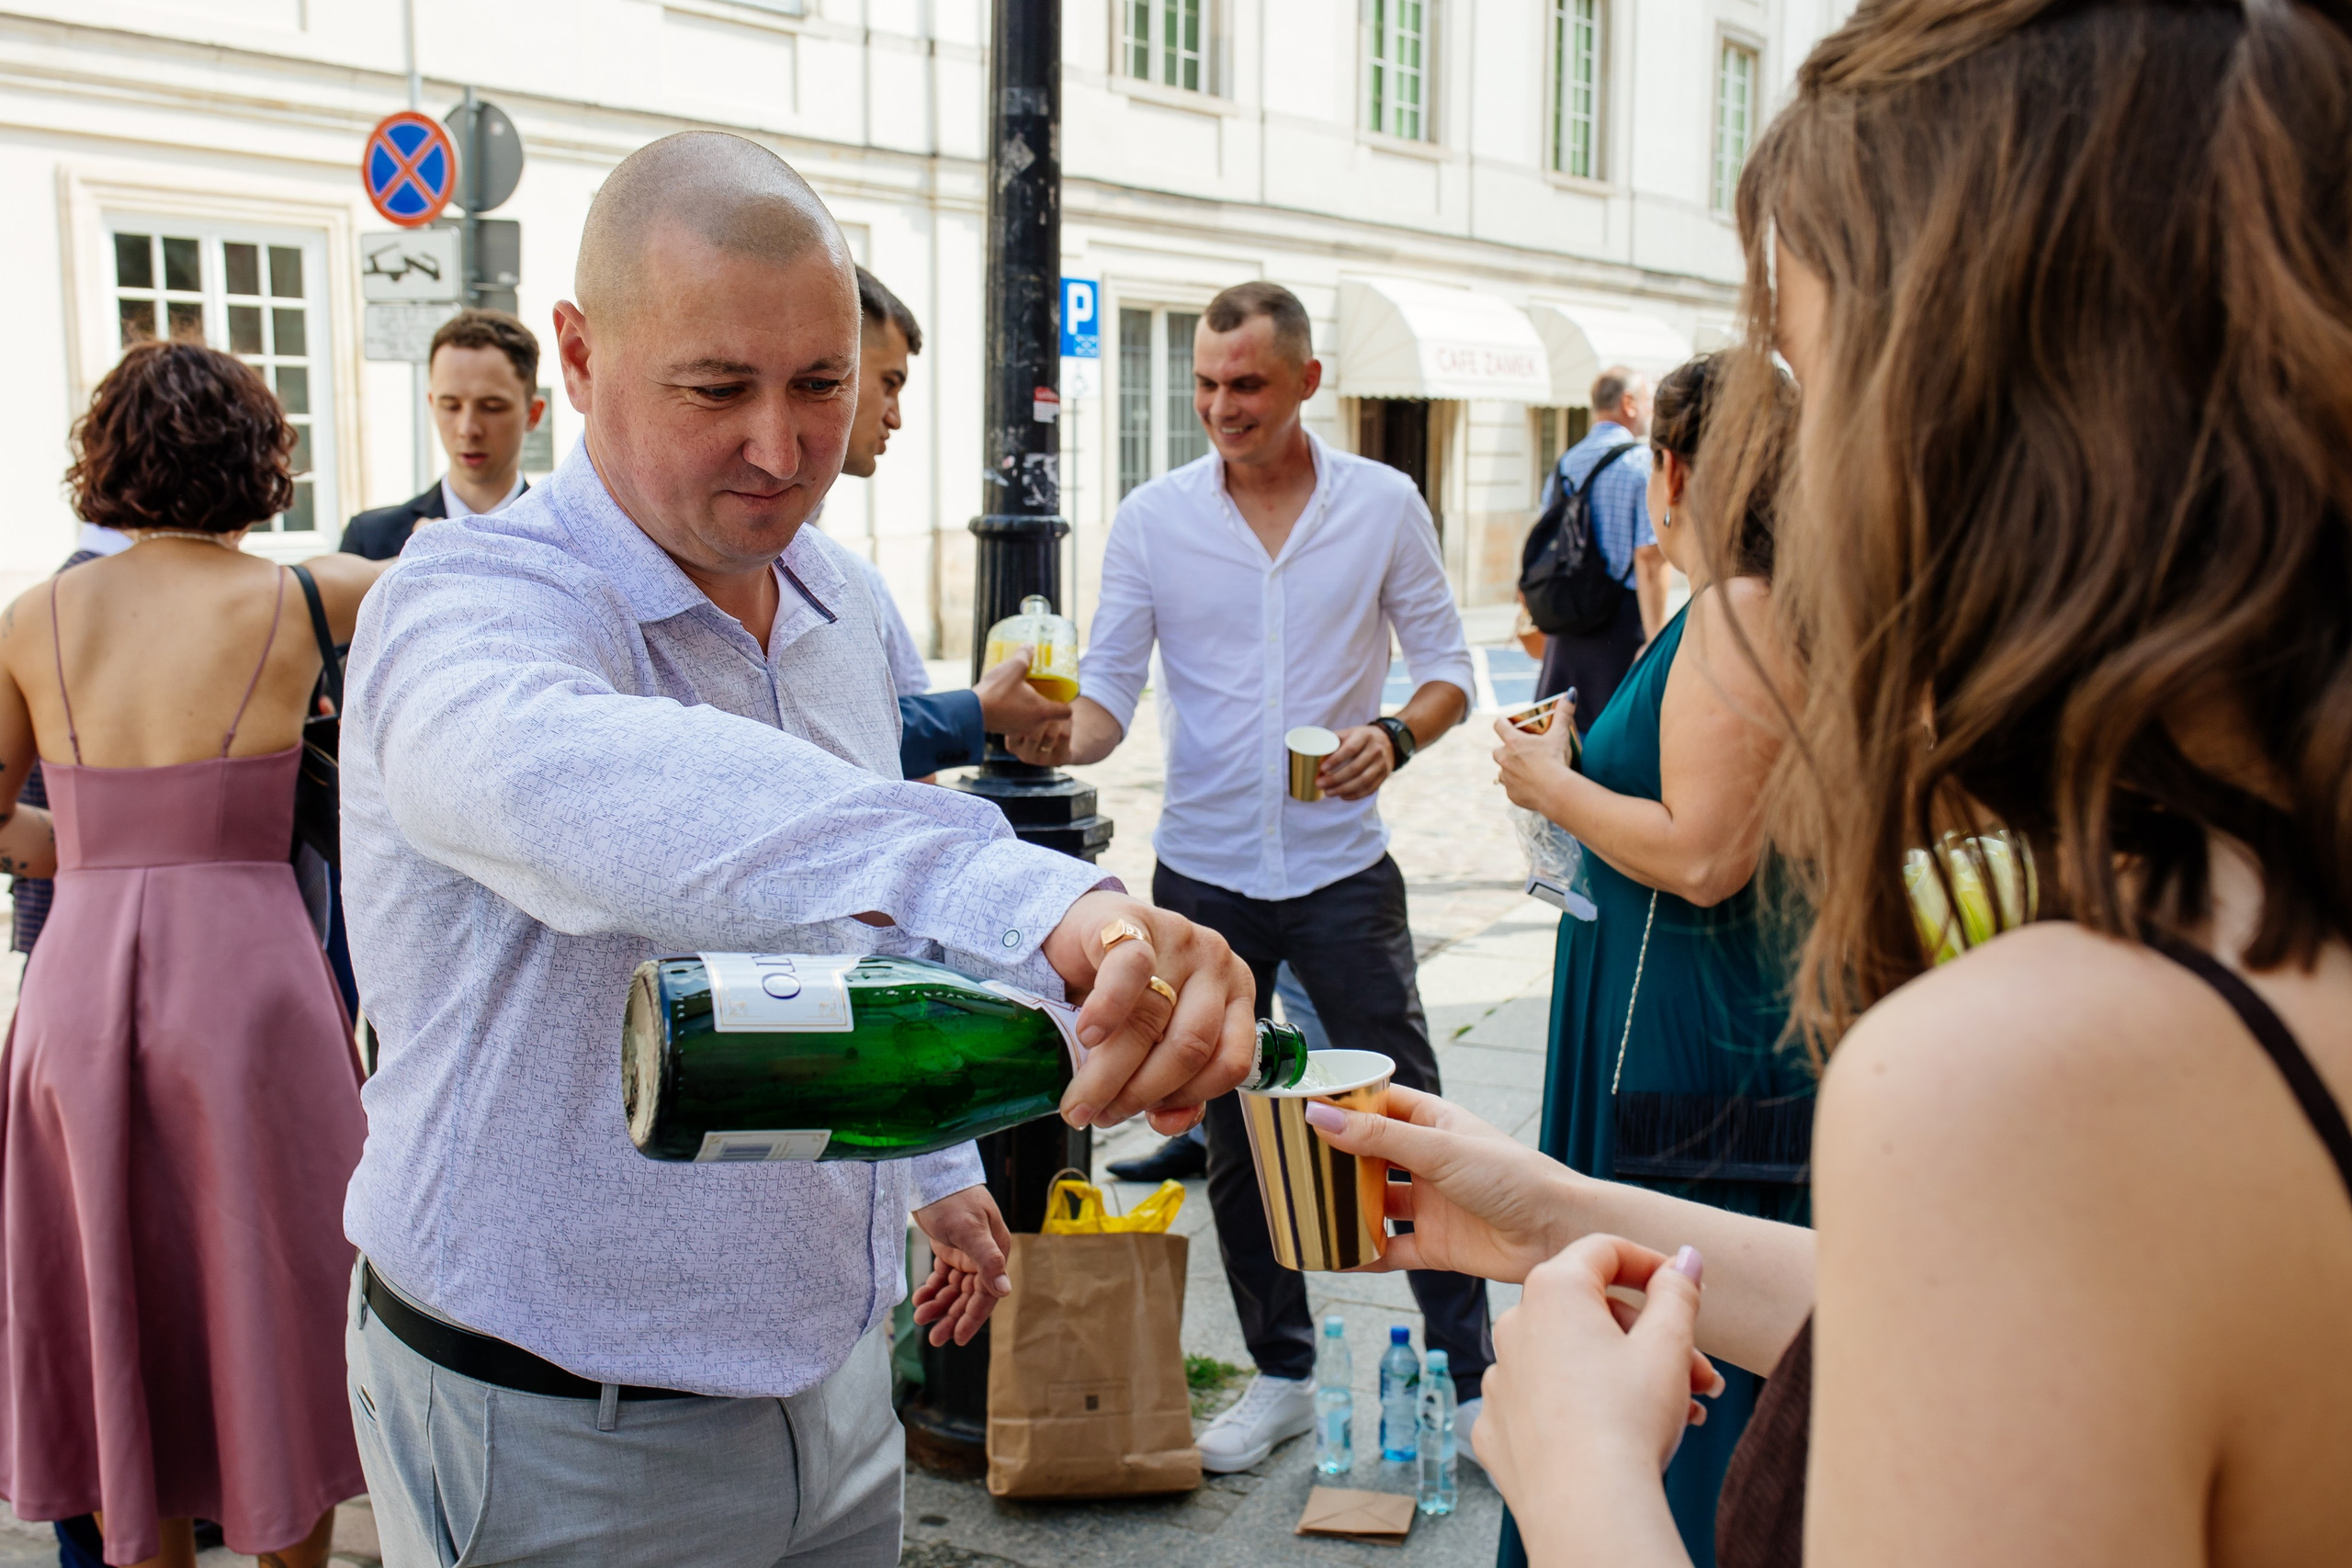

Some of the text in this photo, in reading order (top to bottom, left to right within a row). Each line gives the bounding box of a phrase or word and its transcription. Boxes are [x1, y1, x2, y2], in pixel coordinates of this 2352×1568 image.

[1067, 282, 1093, 335] P
[1437, 348, 1537, 378] CAFE ZAMEK
